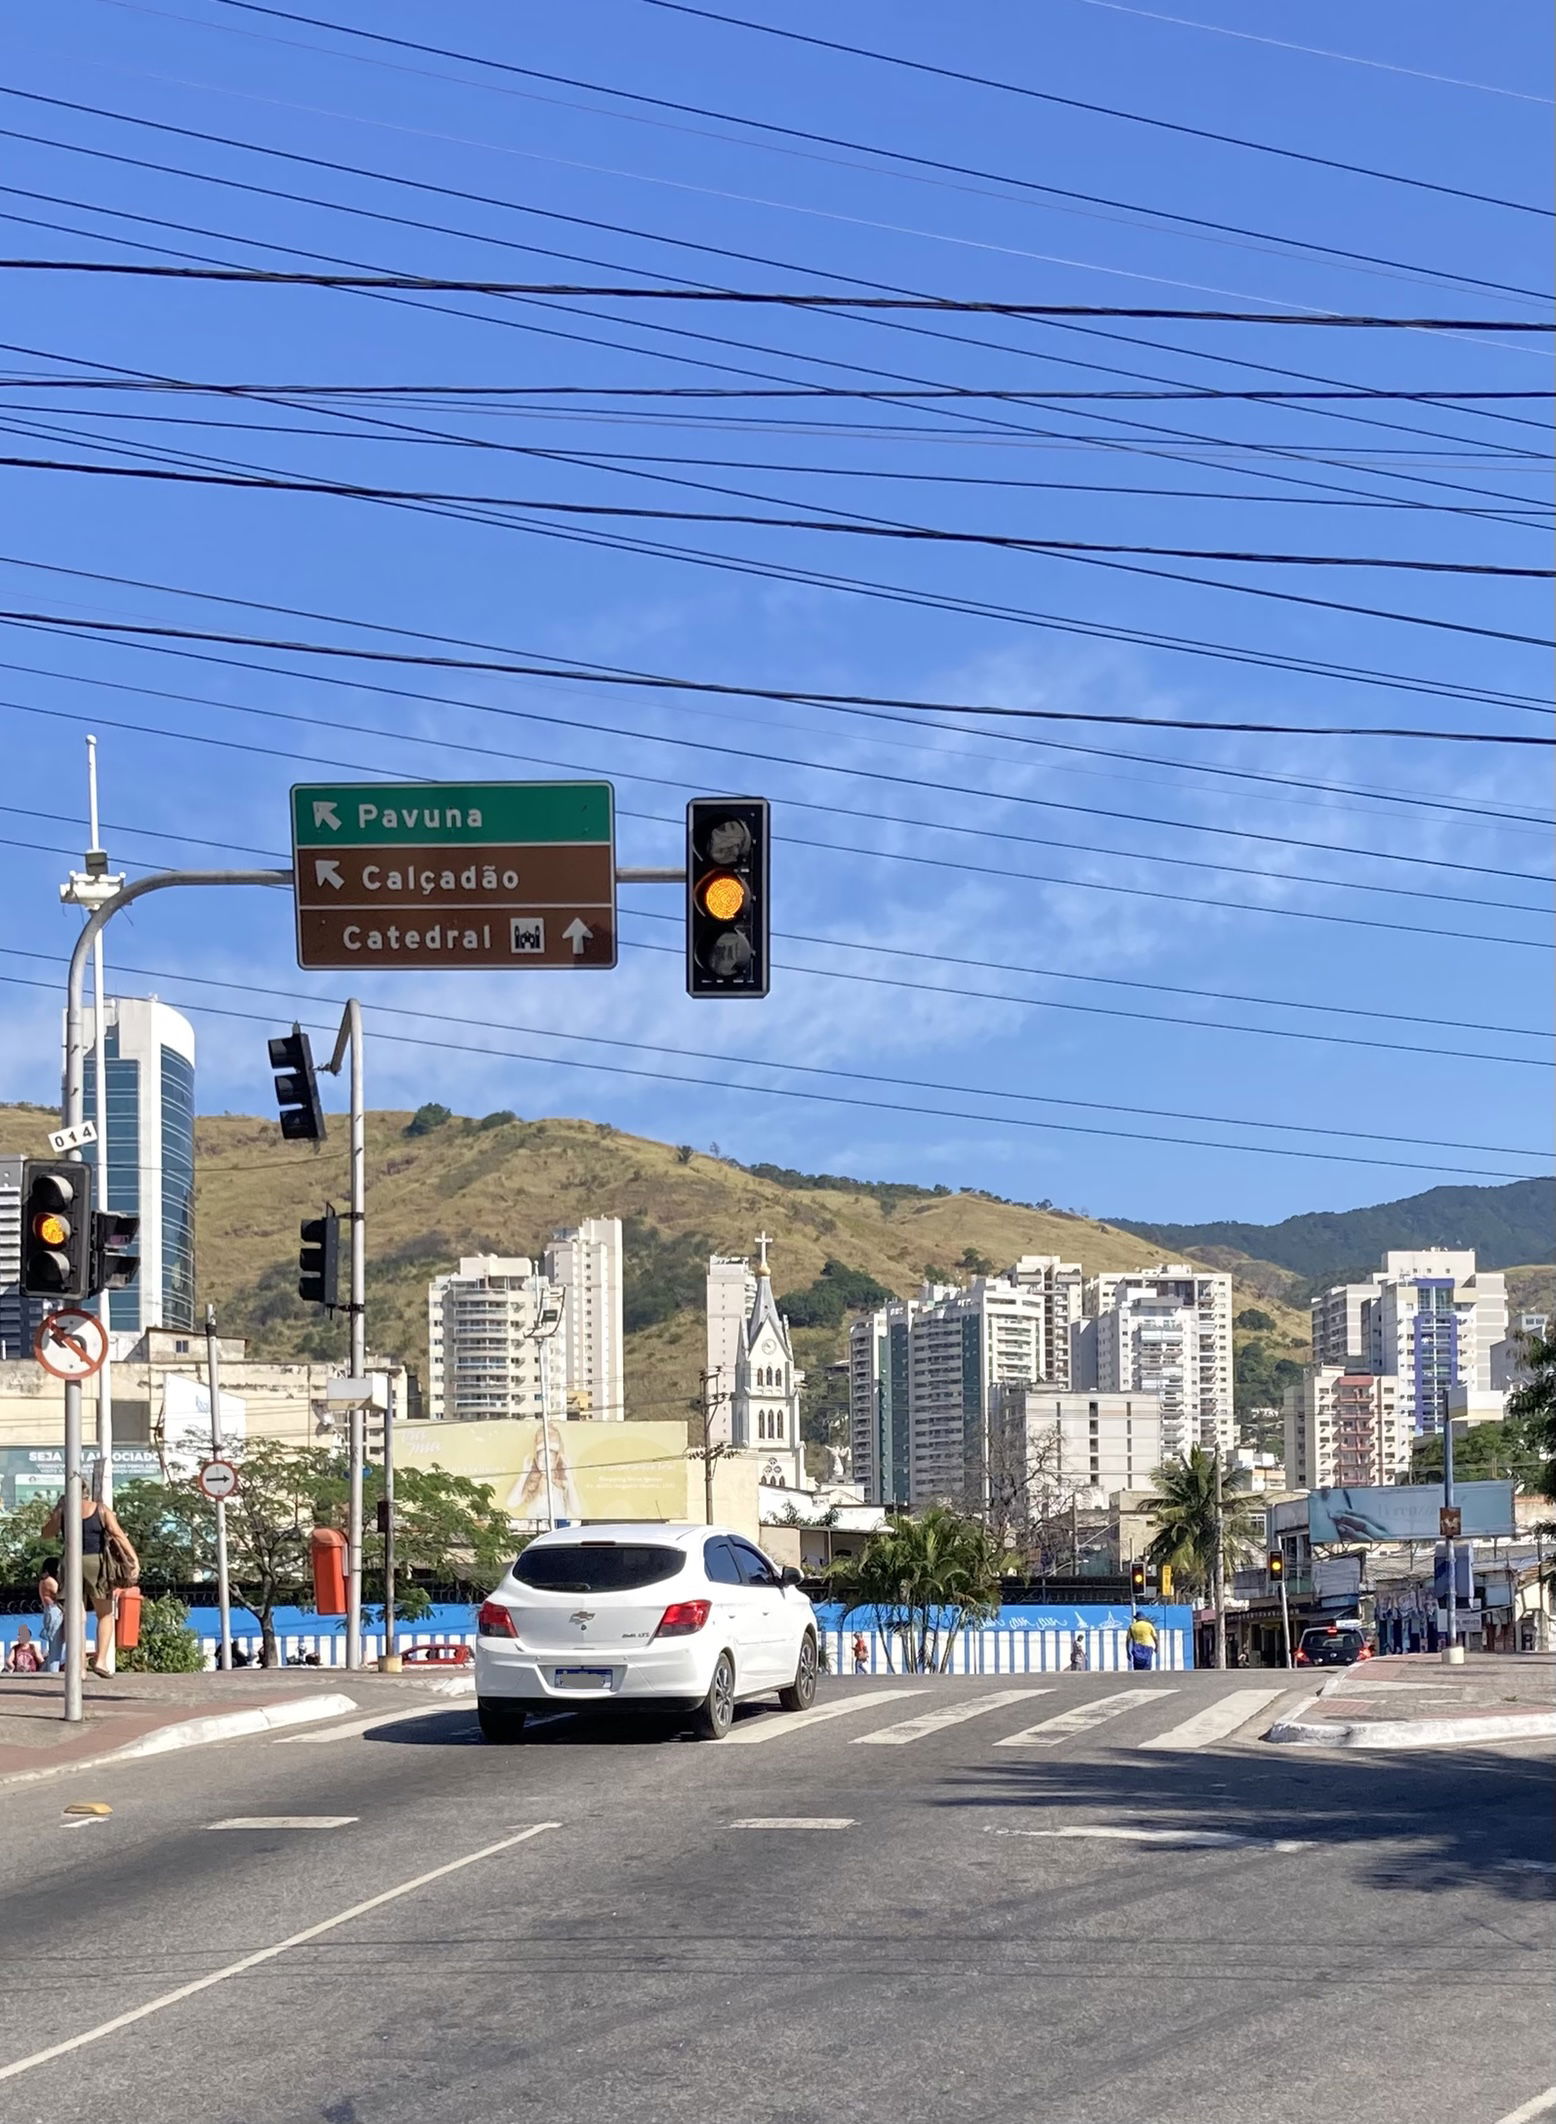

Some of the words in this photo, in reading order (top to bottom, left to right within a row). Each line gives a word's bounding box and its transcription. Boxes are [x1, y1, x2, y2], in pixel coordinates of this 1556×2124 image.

[358, 803, 483, 828] Pavuna
[362, 865, 519, 895] Calçadão
[342, 925, 492, 950] Catedral
[54, 1126, 92, 1147] 014
[28, 1451, 62, 1462] SEJA
[86, 1451, 160, 1462] AOCIADO
